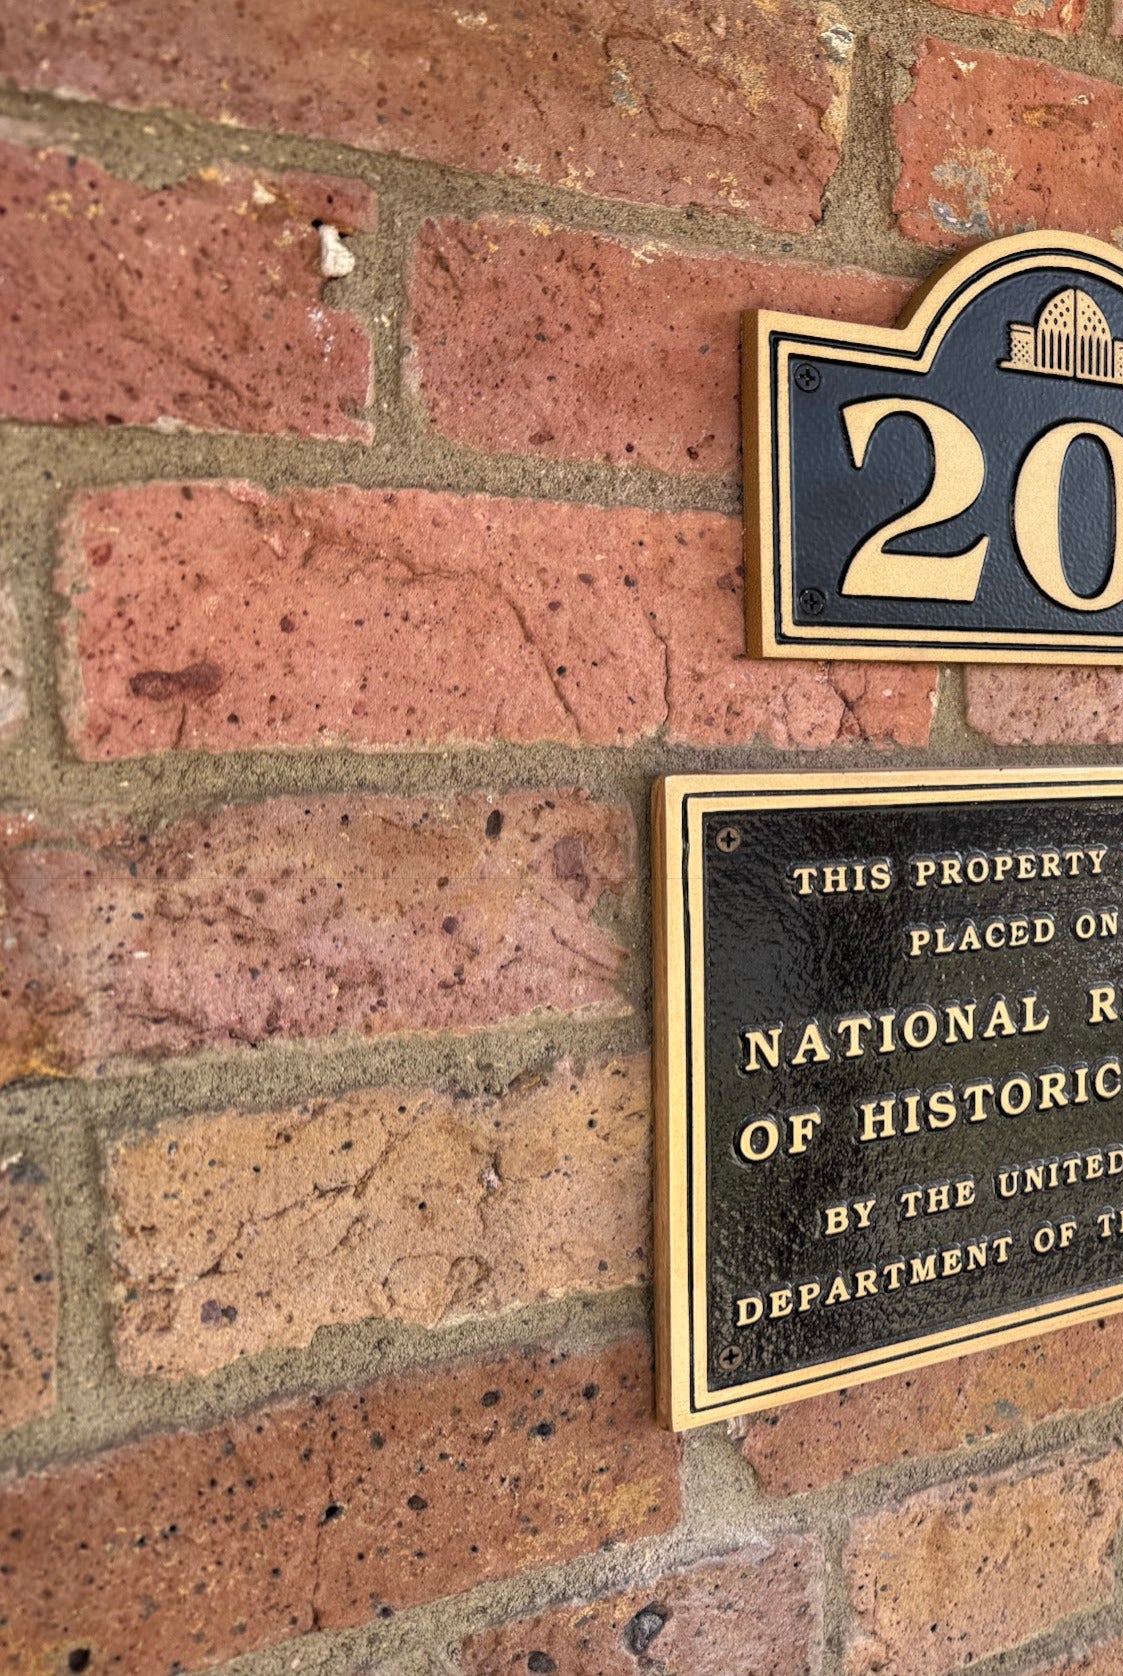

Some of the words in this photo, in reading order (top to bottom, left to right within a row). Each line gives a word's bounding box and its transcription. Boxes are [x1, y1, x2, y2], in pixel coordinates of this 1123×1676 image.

[792, 862, 891, 895] THIS
[916, 846, 1105, 887] PROPERTY
[910, 917, 1055, 956] PLACED
[1074, 912, 1118, 939] ON
[745, 996, 1049, 1071] NATIONAL
[739, 1111, 821, 1161] OF
[860, 1061, 1121, 1141] HISTORIC
[825, 1199, 875, 1235] BY
[901, 1180, 975, 1217] THE
[736, 1236, 1014, 1328] DEPARTMENT
[1033, 1220, 1077, 1253] OF
